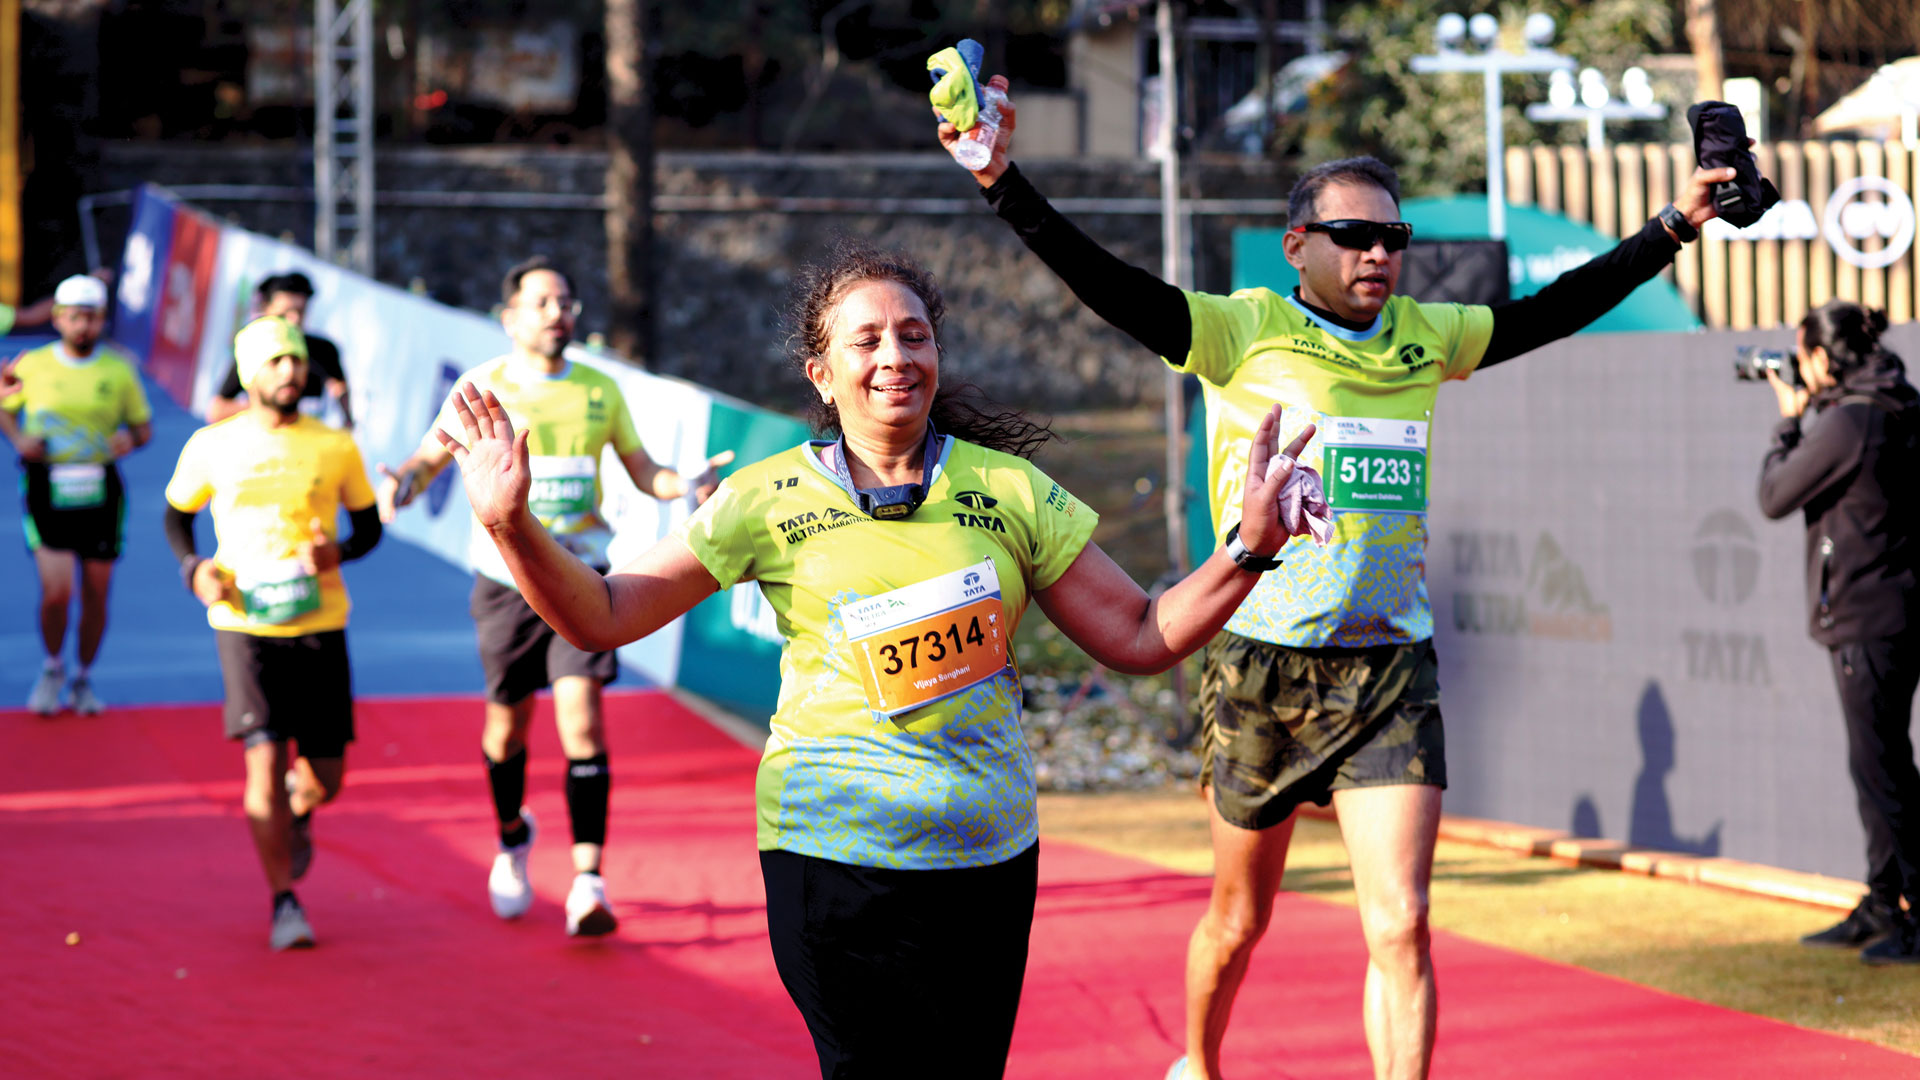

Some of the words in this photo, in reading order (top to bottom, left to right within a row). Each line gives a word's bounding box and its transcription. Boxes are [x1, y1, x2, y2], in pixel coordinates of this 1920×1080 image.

[1340, 456, 1411, 485] 51233
[776, 511, 819, 533] TATA
[786, 522, 827, 544] ULTRA
[952, 513, 1006, 533] TATA
[963, 585, 986, 597] TATA
[879, 616, 985, 676] 37314
[1682, 629, 1772, 686] TATA
[913, 676, 938, 690] Vijaya
